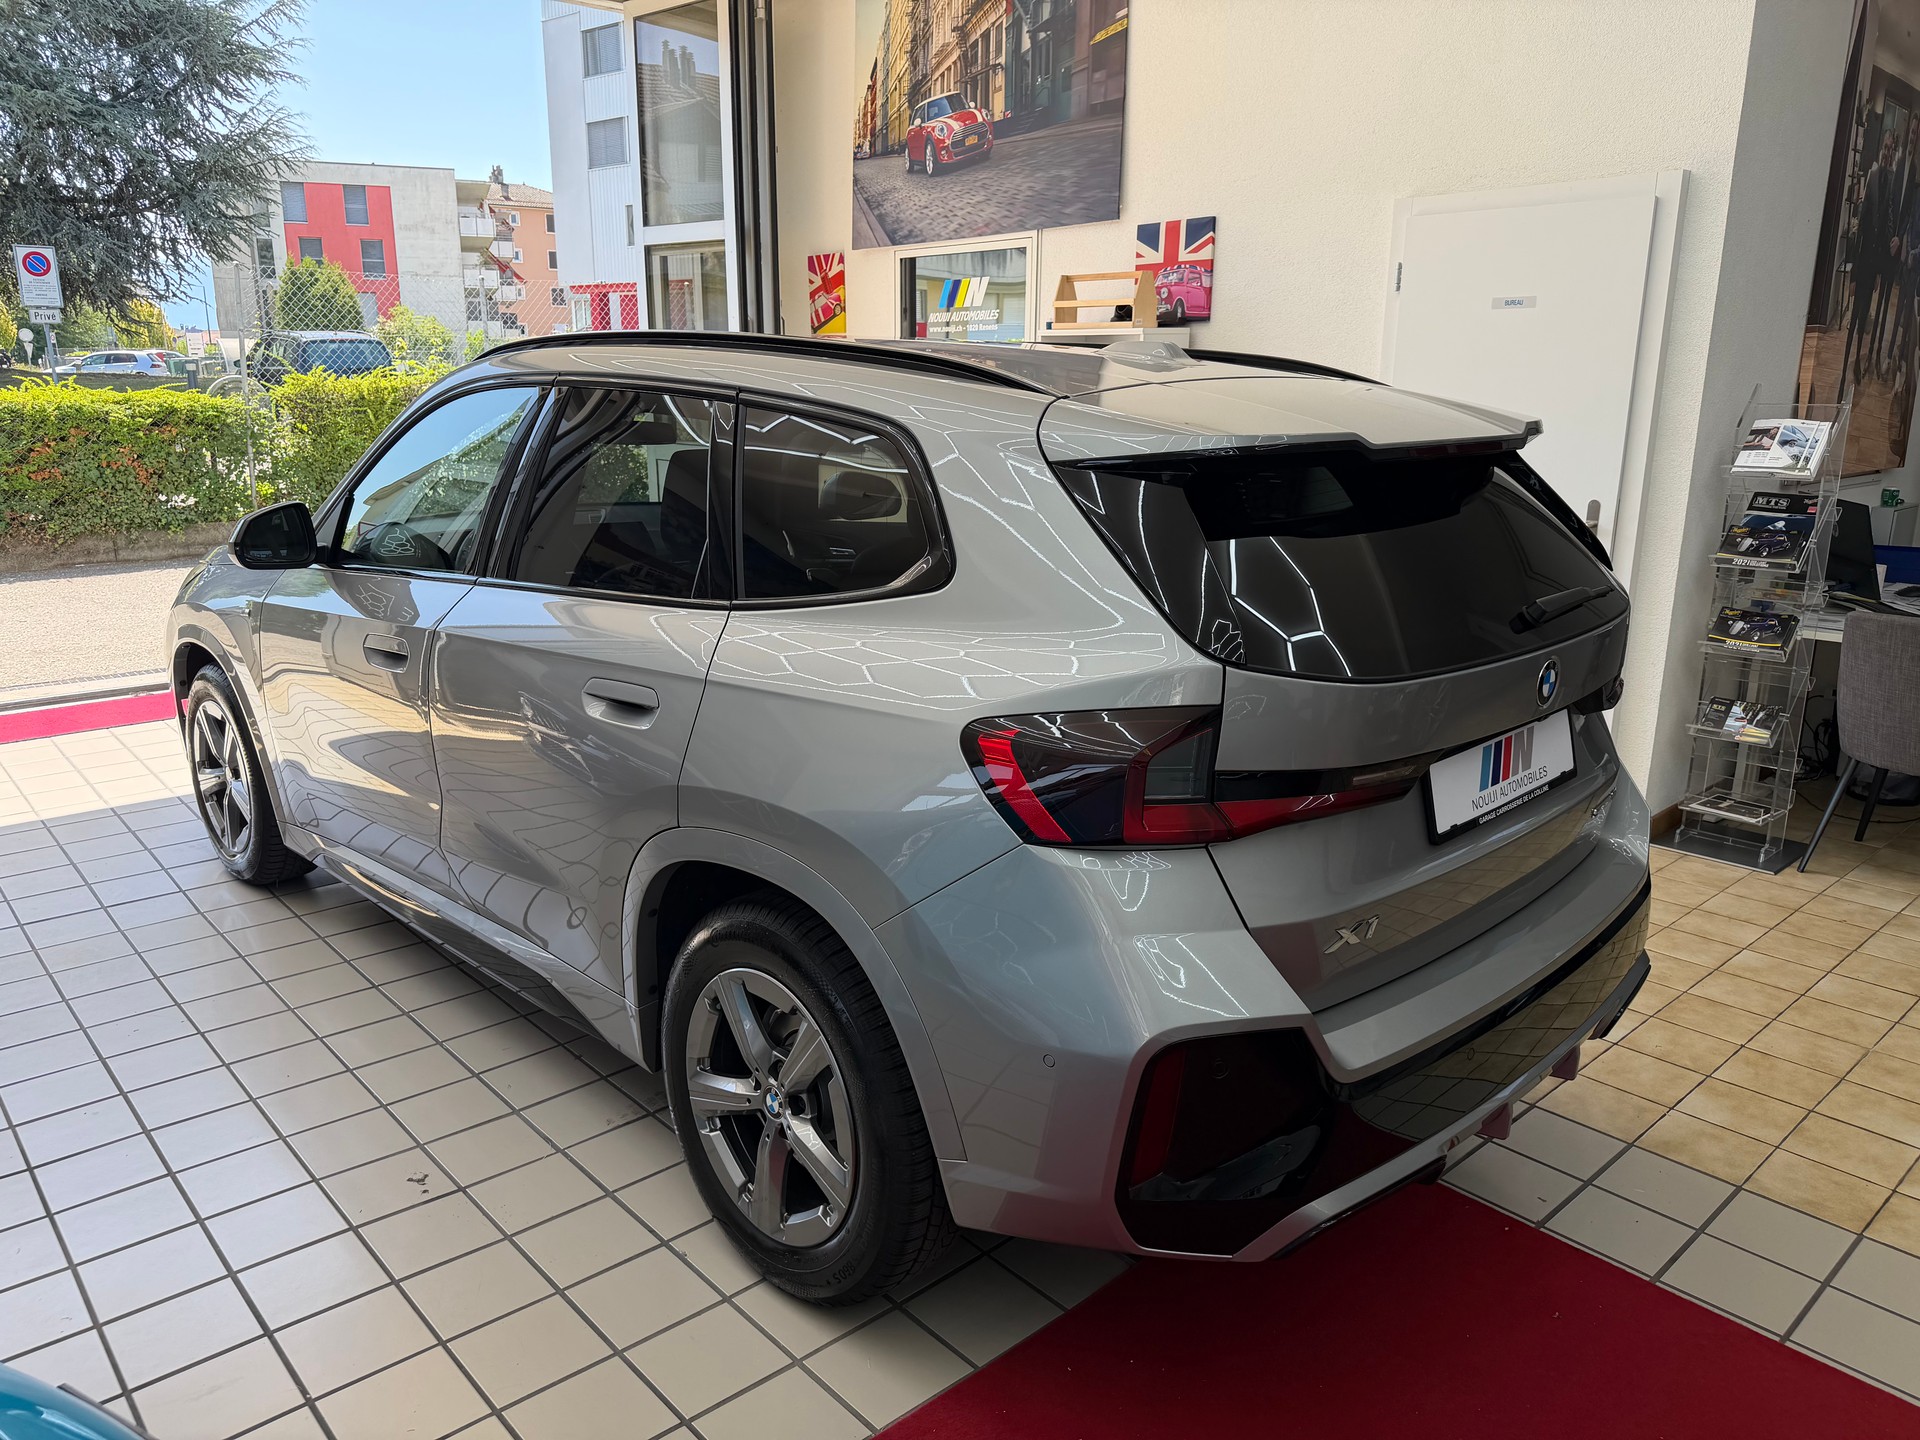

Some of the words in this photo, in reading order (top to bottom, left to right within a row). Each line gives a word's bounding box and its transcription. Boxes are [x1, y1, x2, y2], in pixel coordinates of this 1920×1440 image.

[34, 311, 57, 321] Privé
[950, 309, 1000, 322] AUTOMOBILES
[1755, 496, 1788, 507] MTS
[1732, 558, 1750, 566] 2021
[1471, 792, 1498, 811] NOUIJI
[1500, 765, 1548, 799] AUTOMOBILES
[1479, 811, 1496, 824] GARAGE
[1497, 798, 1523, 815] CARROSSERIE
[1534, 785, 1549, 796] COLLINE
[1323, 914, 1380, 954] X1
